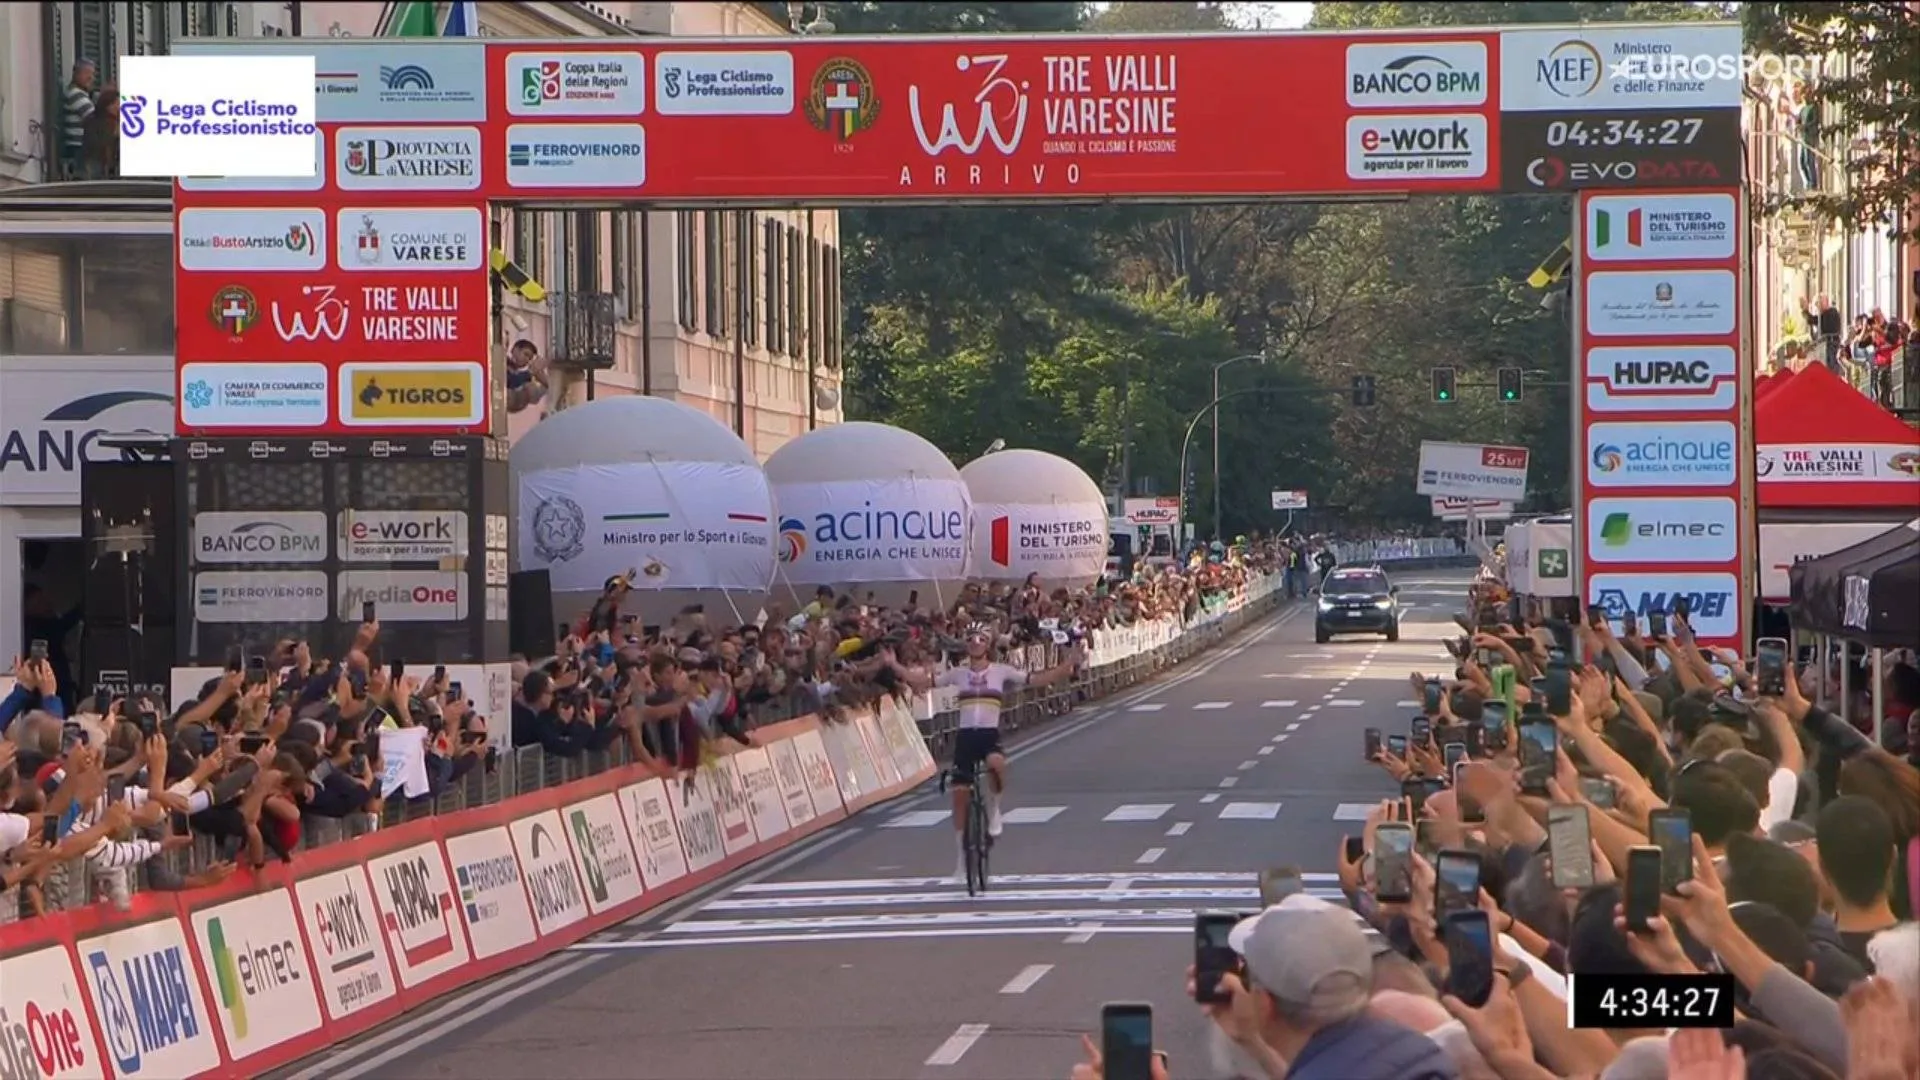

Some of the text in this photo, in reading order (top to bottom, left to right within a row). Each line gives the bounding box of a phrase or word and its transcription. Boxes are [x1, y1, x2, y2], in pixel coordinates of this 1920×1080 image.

[1613, 42, 1672, 54] Ministero
[565, 62, 622, 75] Coppa Italia
[1043, 55, 1177, 92] TRE VALLI
[1537, 57, 1594, 84] MEF
[565, 76, 628, 89] delle Regioni
[687, 70, 774, 84] Lega Ciclismo
[1353, 71, 1480, 94] BANCO BPM
[327, 84, 358, 95] Giovani
[687, 84, 785, 97] Professionistico
[1613, 80, 1705, 93] e delle Finanze
[1043, 97, 1177, 134] VARESINE
[1361, 120, 1469, 151] e-work
[1547, 119, 1703, 146] 04:34:27
[533, 144, 641, 156] FERROVIENORD
[1043, 140, 1076, 153] QUANDO
[1078, 141, 1086, 153] IL
[1089, 140, 1127, 152] CICLISMO
[1137, 140, 1177, 152] PASSIONE
[367, 139, 472, 176] PROVINCIA
[1364, 158, 1468, 172] agenzia per il lavoro
[397, 160, 473, 176] VARESE
[899, 164, 1080, 185] ARRIVO
[1570, 159, 1721, 181] EVODATA
[1650, 212, 1712, 221] MINISTERO
[1650, 221, 1726, 232] DEL TURISMO
[391, 232, 467, 245] COMUNE DI
[392, 245, 467, 261] VARESE
[362, 287, 458, 311] TRE VALLI
[362, 316, 458, 340] VARESINE
[1614, 360, 1710, 385] HUPAC
[262, 382, 271, 390] DI
[272, 382, 324, 390] COMMERCIO
[386, 387, 465, 404] TIGROS
[1626, 436, 1731, 461] acinque
[1783, 450, 1863, 461] TRE VALLI
[1626, 462, 1731, 472] ENERGIA CHE UNISCE
[1783, 461, 1863, 472] VARESINE
[1440, 471, 1523, 486] FERROVIENORD
[351, 516, 451, 539] e-work
[815, 501, 962, 542] acinque
[1021, 521, 1091, 534] MINISTERO
[1638, 521, 1724, 537] elmec
[202, 534, 320, 551] BANCO BPM
[603, 531, 656, 545] Ministro
[660, 532, 679, 546] per
[684, 530, 696, 543] lo
[698, 529, 727, 544] Sport
[1021, 533, 1102, 548] DEL TURISMO
[354, 546, 391, 554] agenzia
[394, 546, 410, 555] per
[421, 545, 451, 553] lavoro
[815, 546, 962, 562] ENERGIA CHE UNISCE
[222, 587, 324, 597] FERROVIENORD
[347, 586, 457, 603] MediaOne
[384, 856, 440, 931] HUPAC
[315, 873, 370, 956] e-work
[237, 939, 300, 995] elmec
[123, 947, 199, 1053] MAPEI
